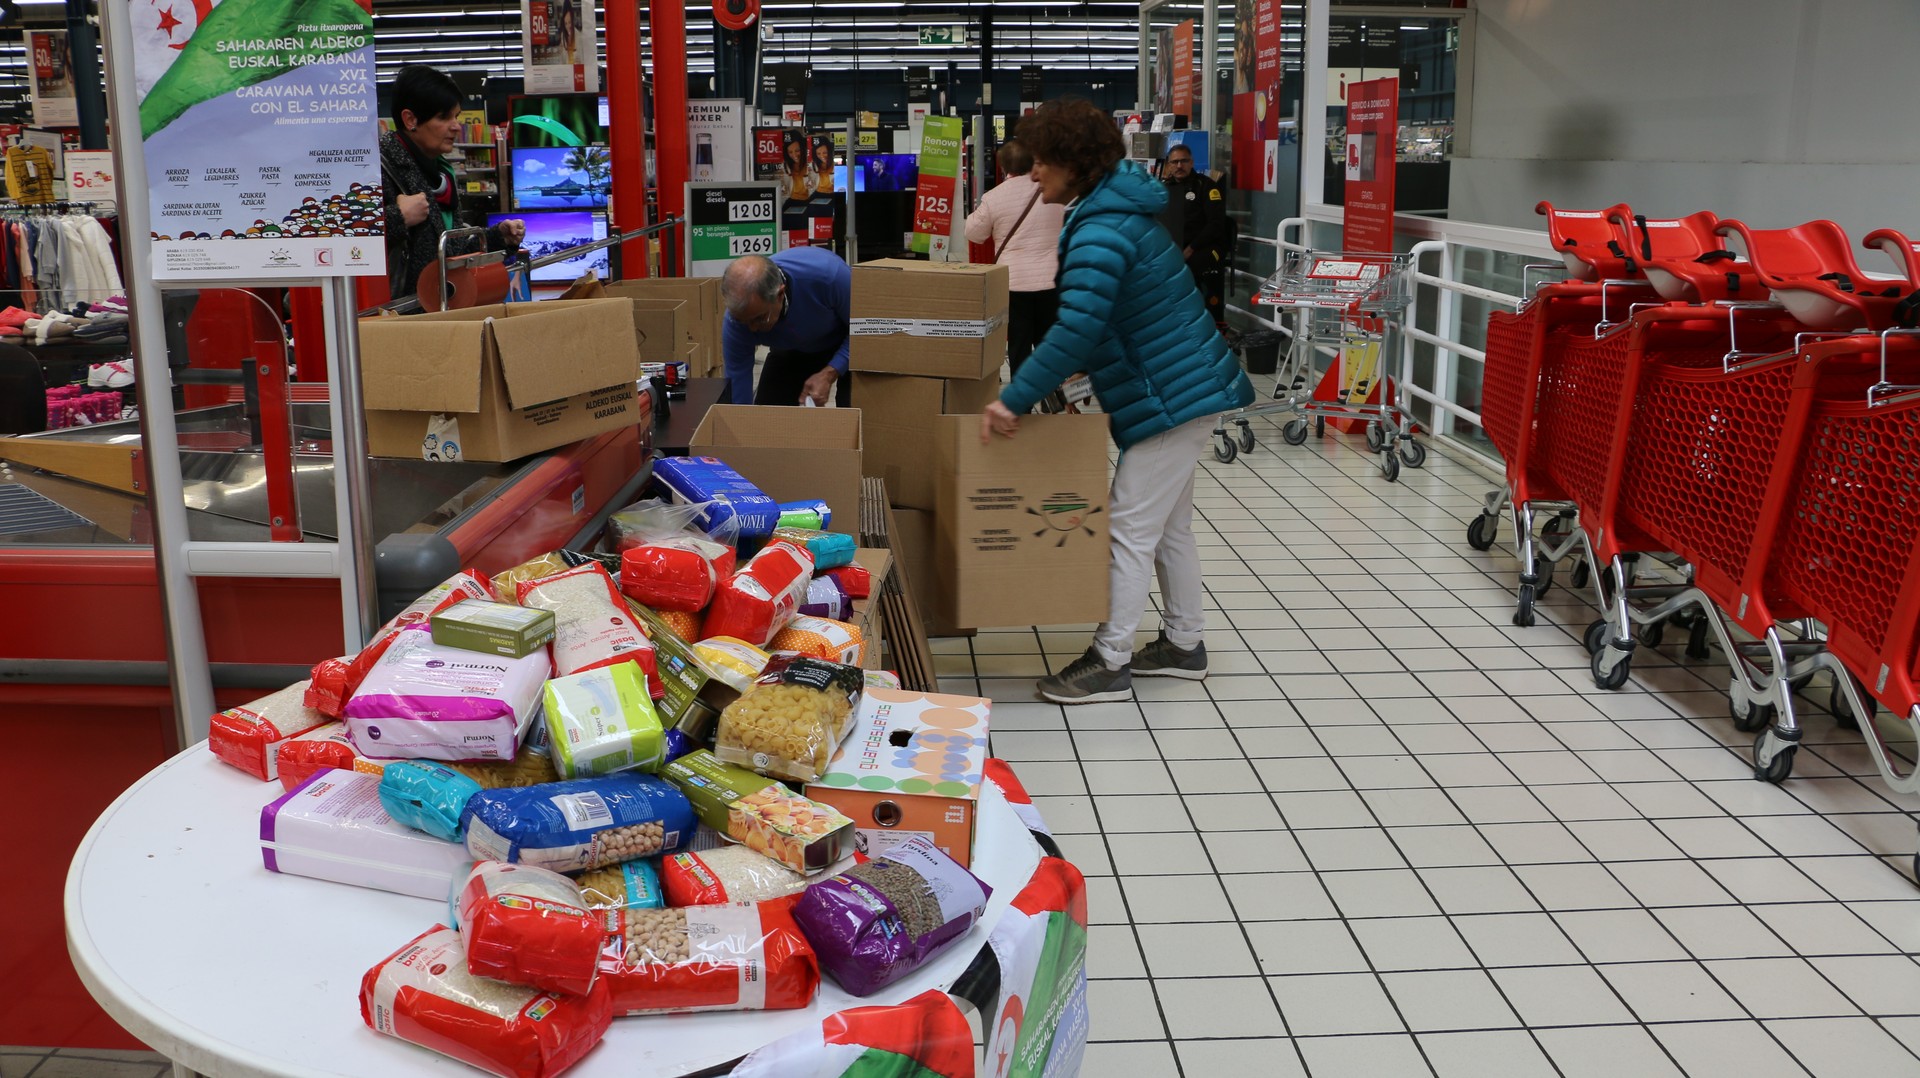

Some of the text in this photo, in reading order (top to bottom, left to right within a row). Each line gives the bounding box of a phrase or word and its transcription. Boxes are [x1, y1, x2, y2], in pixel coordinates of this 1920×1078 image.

[297, 23, 364, 32] Piztu itxaropena
[216, 36, 366, 52] SAHARAREN ALDEKO
[229, 52, 366, 68] EUSKAL KARABANA
[340, 69, 367, 81] XVI
[480, 77, 487, 87] 7
[236, 83, 366, 98] CARAVANA VASCA
[251, 100, 368, 114] CON EL SAHARA
[688, 105, 730, 113] EMIUM
[1351, 100, 1367, 109] SERVICIO
[1370, 98, 1390, 108] DOMICILIO
[274, 116, 310, 125] Alimenta
[328, 116, 368, 125] esperanza
[1375, 112, 1384, 121] peso
[758, 140, 779, 154] 50€
[924, 136, 957, 147] Renove
[923, 145, 949, 156] Plana
[73, 172, 92, 188] 5€
[732, 203, 771, 219] 1208
[693, 227, 704, 237] 95
[586, 391, 633, 410] ALDEKO EUSKAL
[594, 405, 627, 419] KARABANA
[734, 514, 766, 529] SONIA
[461, 582, 480, 600] basic
[489, 637, 515, 646] SARDINAS
[610, 636, 635, 645] basic
[451, 663, 508, 673] Normal
[667, 681, 682, 696] ACEITE
[431, 710, 440, 718] 20
[463, 735, 495, 743] Normal
[901, 843, 938, 866] Pardina
[402, 947, 427, 967] basic
[1021, 994, 1059, 1061] SAHARAREN
[1060, 958, 1084, 1000] ALDEKO
[1072, 990, 1085, 1015] XVI
[383, 1008, 393, 1034] basic
[1027, 1026, 1052, 1072] EUSKAL
[1051, 974, 1084, 1031] KARABANA
[1067, 1004, 1086, 1039] VASCA
